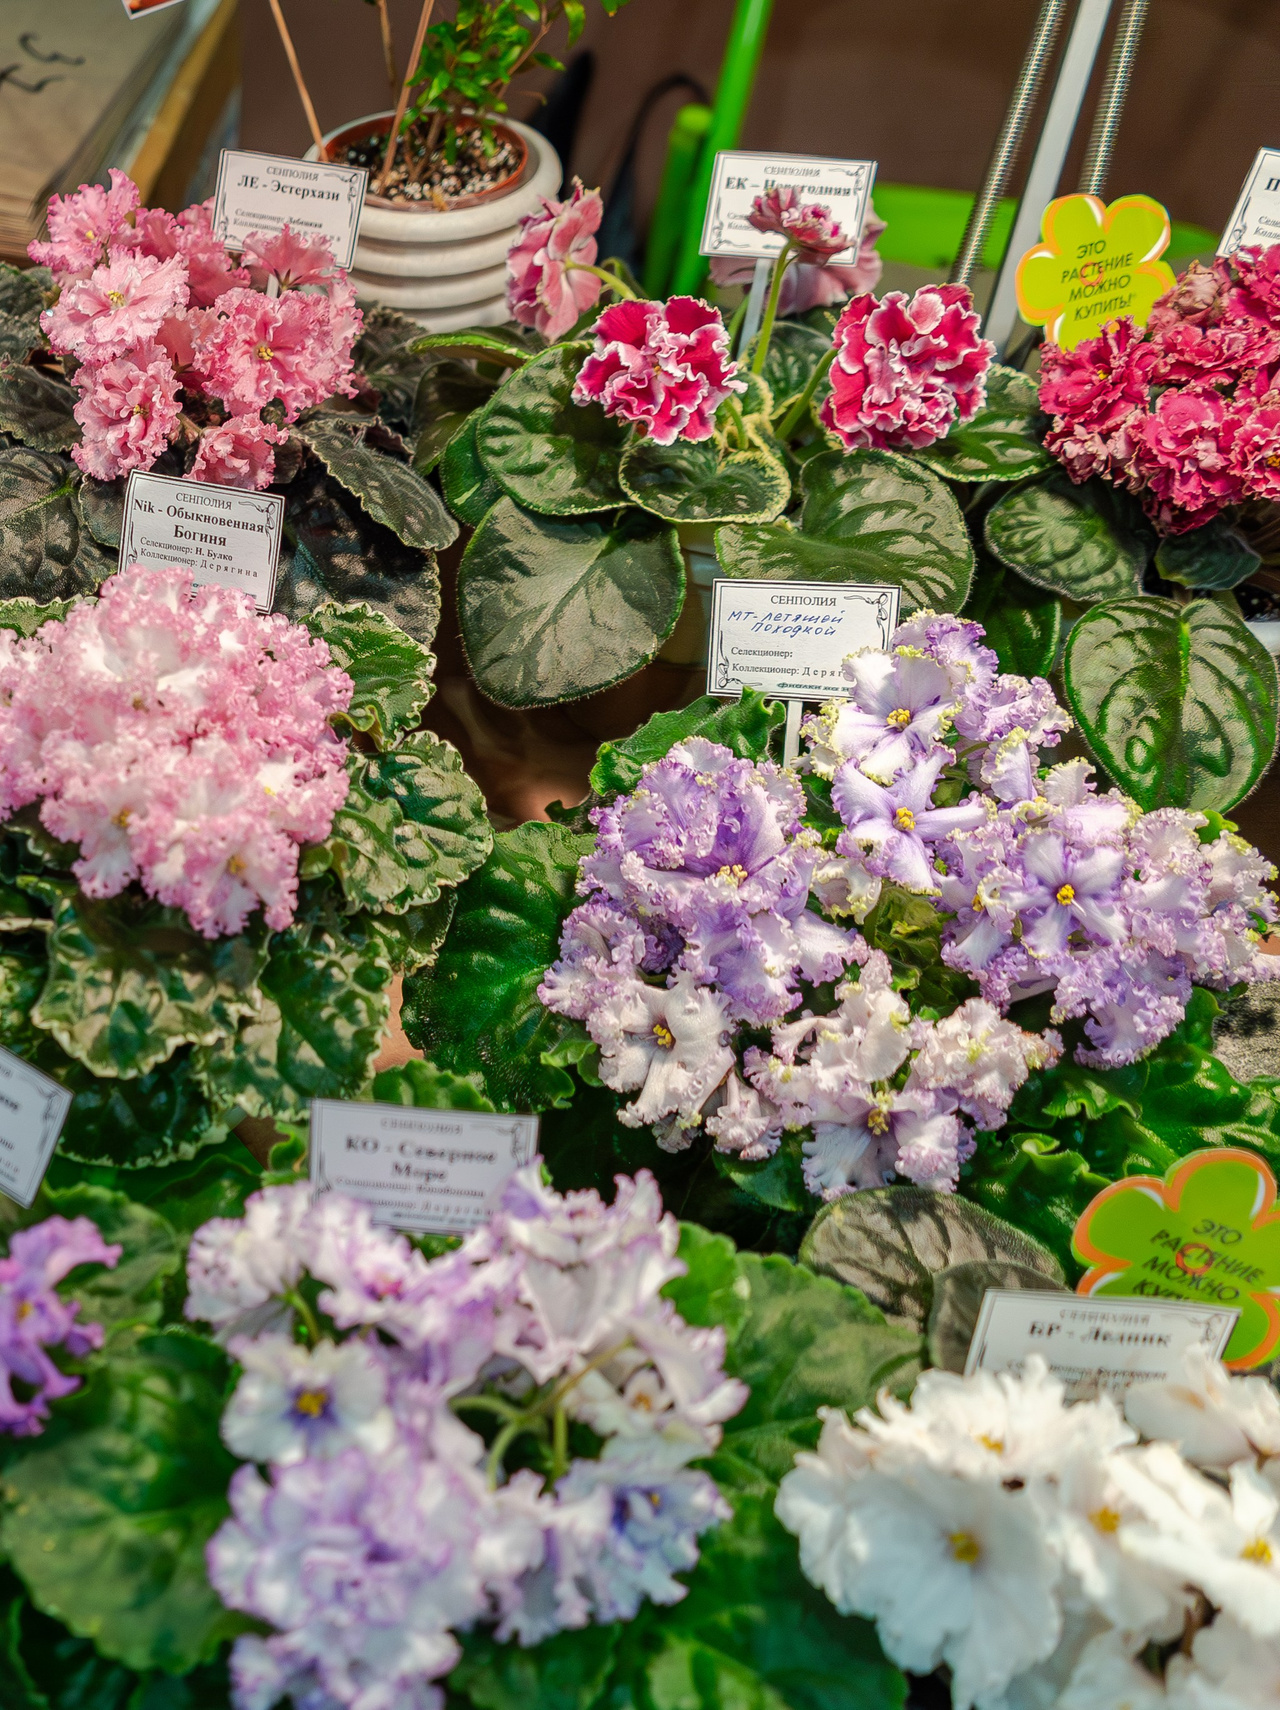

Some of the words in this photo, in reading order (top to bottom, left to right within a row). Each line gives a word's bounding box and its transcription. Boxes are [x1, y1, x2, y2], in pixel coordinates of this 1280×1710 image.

[266, 166, 320, 181] СЕНПОЛИЯ
[725, 176, 748, 190] ЕК
[237, 175, 259, 189] ЛЕ
[270, 180, 340, 201] Эстерхази
[1077, 240, 1106, 259] ЭТО
[1061, 252, 1133, 284] РАСТЕНИЕ
[1069, 274, 1131, 302] МОЖНО
[1073, 295, 1132, 321] КУПИТЬ!
[175, 492, 232, 510] СЕНПОЛИЯ
[133, 499, 155, 514] Nik
[166, 505, 265, 534] Обыкновенная
[173, 524, 227, 547] Богиня
[140, 537, 193, 555] Селекционер:
[195, 547, 205, 556] Н.
[207, 549, 233, 561] Булко
[140, 548, 198, 567] Коллекционер:
[770, 595, 837, 607] СЕНПОЛИЯ
[731, 647, 793, 658] Селекционер:
[732, 663, 799, 675] Коллекционер:
[345, 1136, 379, 1154] КО
[393, 1161, 446, 1182] Море
[1193, 1219, 1242, 1245] ЭТО
[1150, 1229, 1264, 1284] РАСТЕНИЕ
[1141, 1256, 1239, 1301] МОЖНО
